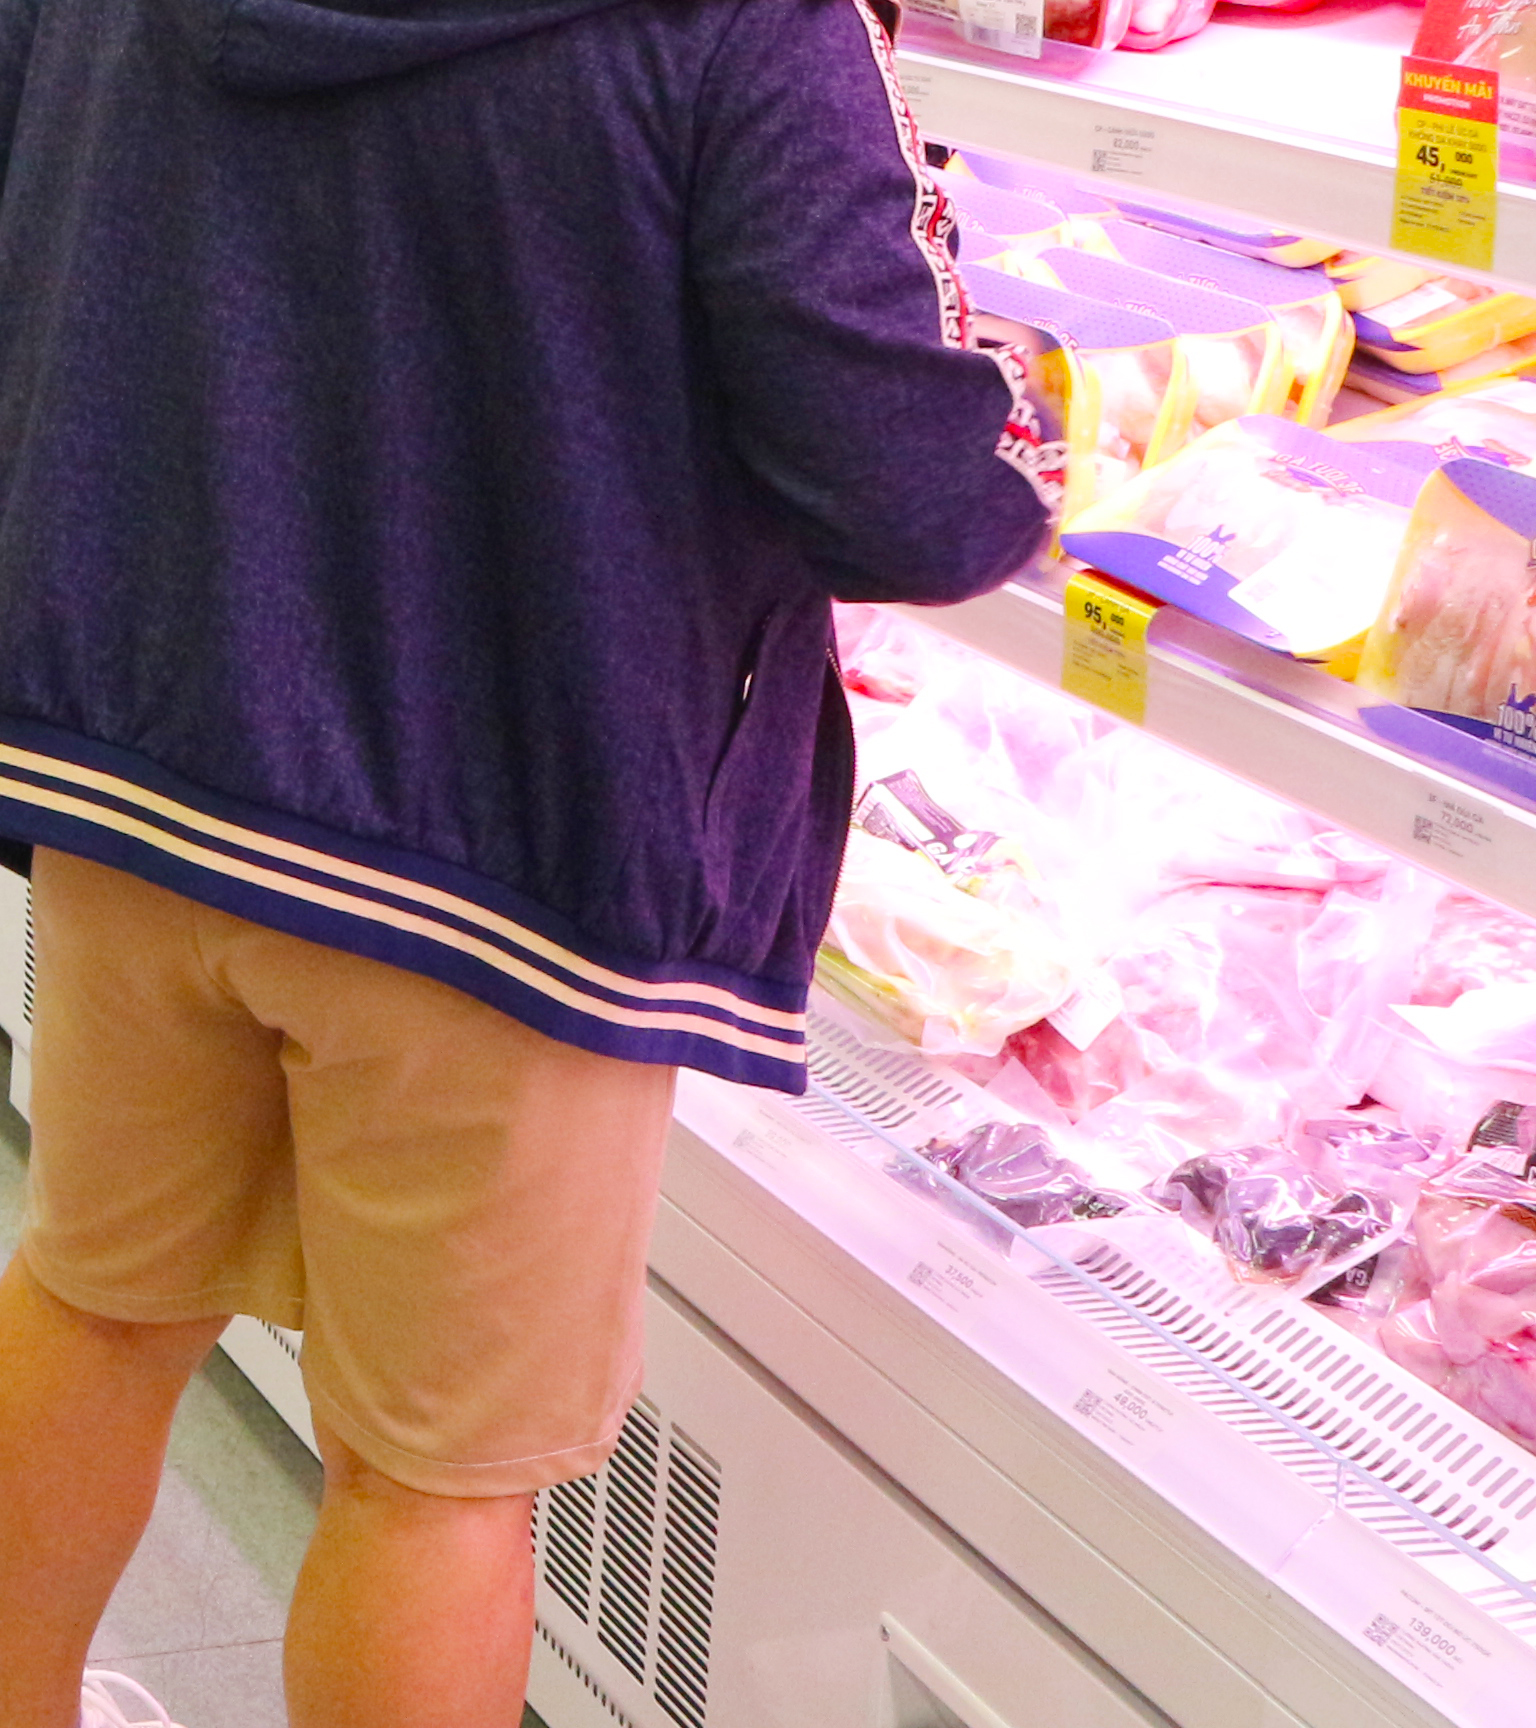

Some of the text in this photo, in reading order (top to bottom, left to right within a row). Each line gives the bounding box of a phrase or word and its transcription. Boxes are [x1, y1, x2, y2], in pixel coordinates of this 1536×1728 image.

[1404, 69, 1494, 100] KHUYẾN MÃI
[1408, 1616, 1457, 1657] 139,000
